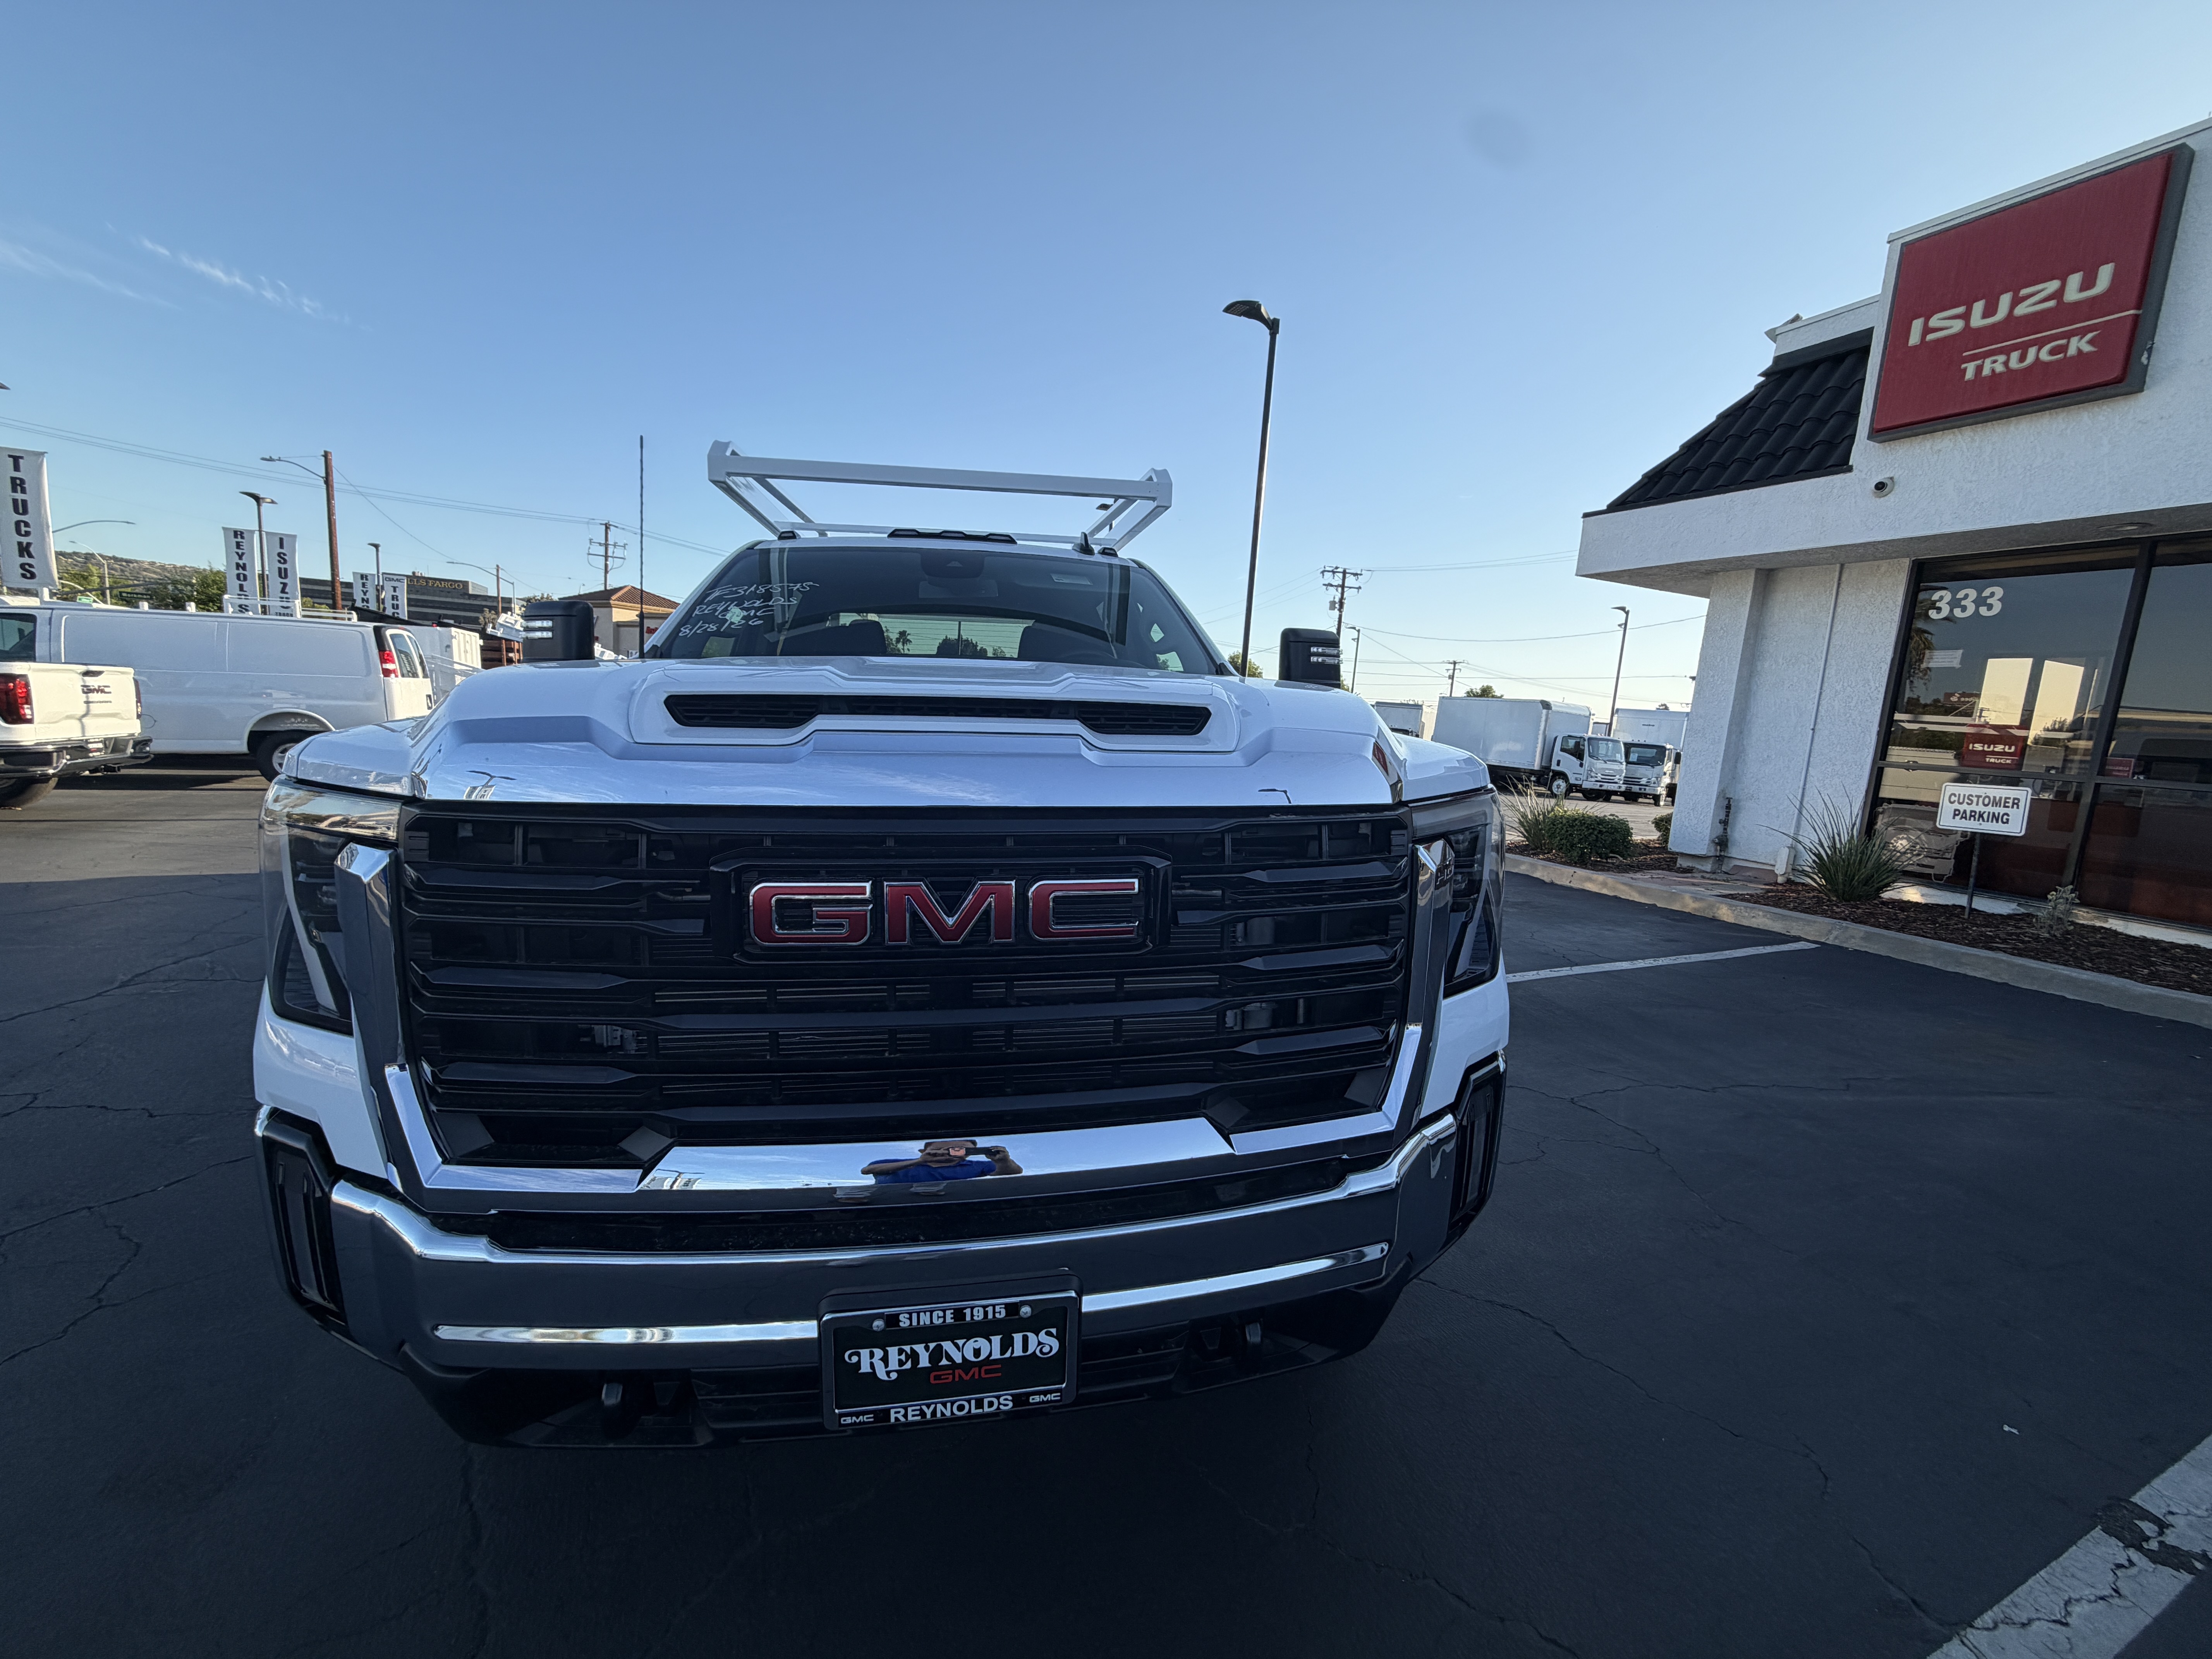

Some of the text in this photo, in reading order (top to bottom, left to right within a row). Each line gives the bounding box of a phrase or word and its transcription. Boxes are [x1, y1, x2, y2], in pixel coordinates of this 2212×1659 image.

[1908, 262, 2115, 347] ISUZU
[1961, 330, 2101, 381] TRUCK
[7, 454, 37, 580] TRUCKS
[429, 580, 463, 589] FARGO
[1928, 586, 2004, 619] 333
[81, 684, 112, 694] GMC
[1968, 743, 2015, 752] ISUZU
[1948, 793, 2021, 810] CUSTOMER
[1952, 808, 2010, 824] PARKING
[749, 878, 1139, 946] GMC
[899, 1305, 1006, 1327] SINCE 1915
[844, 1328, 1059, 1381] REYNOLDS
[929, 1364, 1002, 1384] GMC
[840, 1392, 1061, 1424] GMC REYNOLDS GMC
